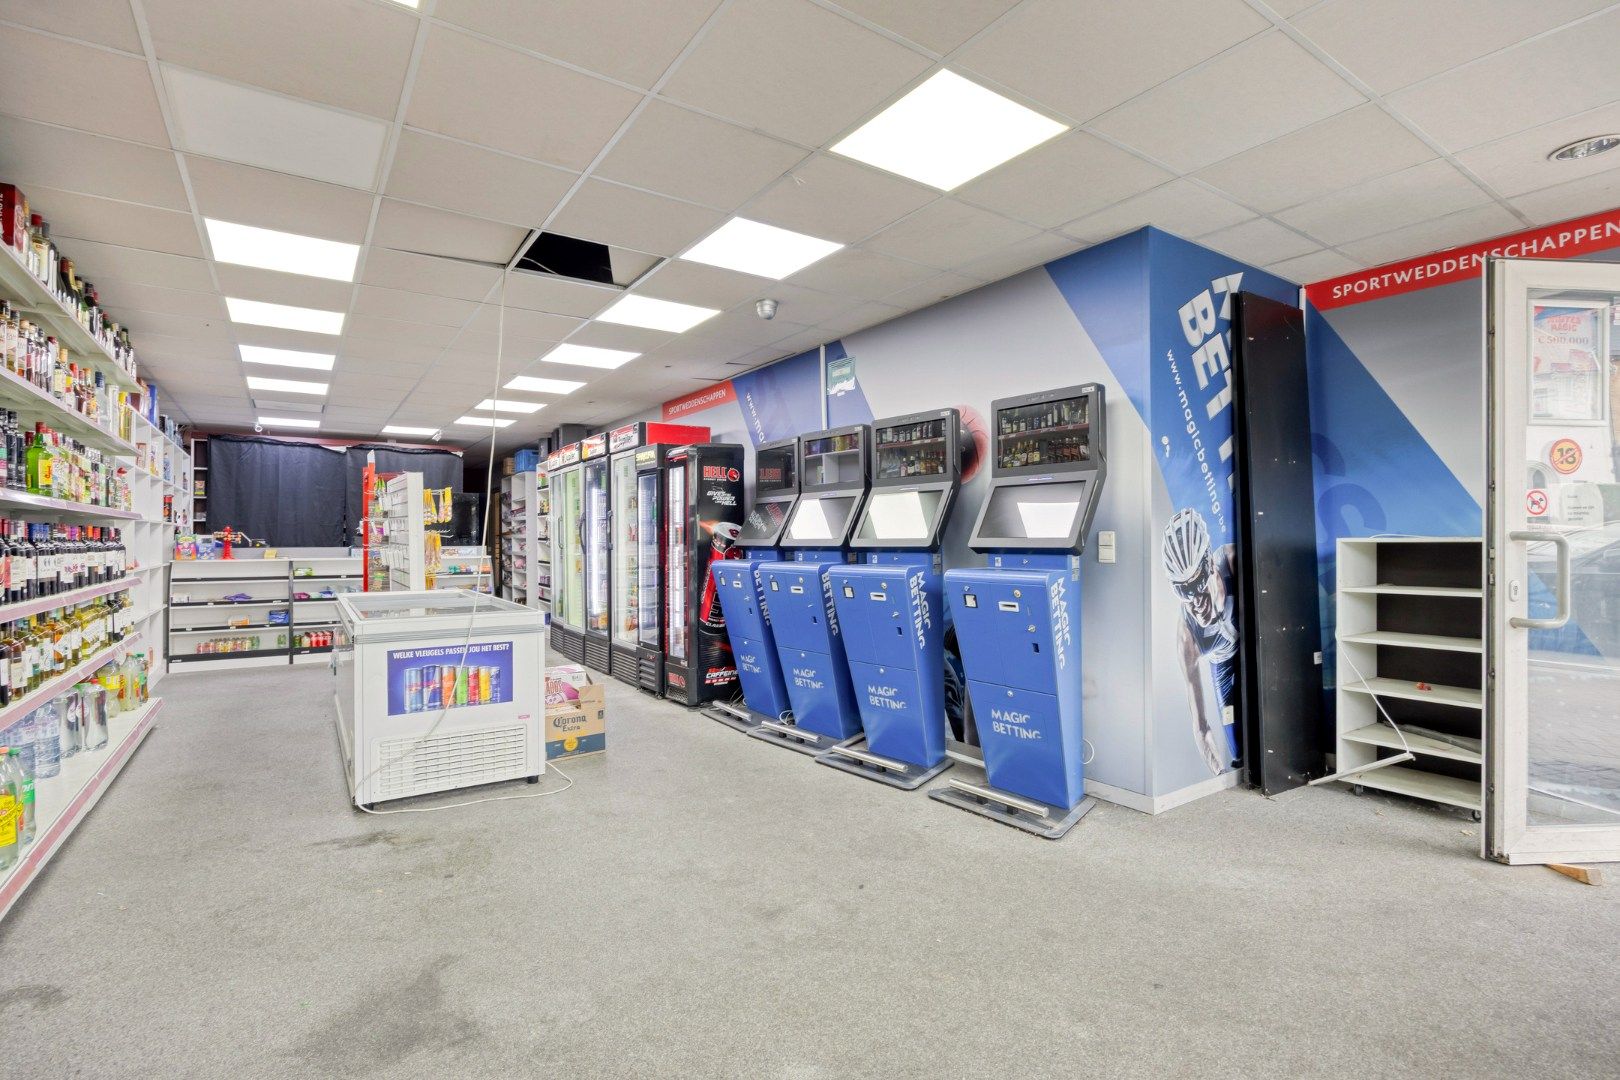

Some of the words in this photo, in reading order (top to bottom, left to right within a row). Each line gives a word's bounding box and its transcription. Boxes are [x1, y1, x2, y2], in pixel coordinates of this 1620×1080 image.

[668, 388, 727, 416] SPORTWEDDENSCHAPPEN
[746, 392, 767, 443] www.ma
[1166, 349, 1227, 533] www.magicbetting.be
[703, 466, 727, 479] HELL
[821, 571, 840, 636] BETTING
[1057, 577, 1072, 647] MAGIC
[909, 575, 926, 650] BETTING
[1050, 583, 1066, 670] BETTING
[393, 650, 414, 659] WELKE
[415, 648, 445, 657] VLEUGELS
[492, 643, 510, 651] BEST?
[793, 667, 817, 677] MAGIC
[794, 677, 825, 689] BETTING
[868, 685, 898, 697] MAGIC
[869, 695, 909, 710] BETTING
[553, 714, 587, 728] Corona
[991, 708, 1031, 724] MAGIC
[992, 721, 1043, 740] BETTING
